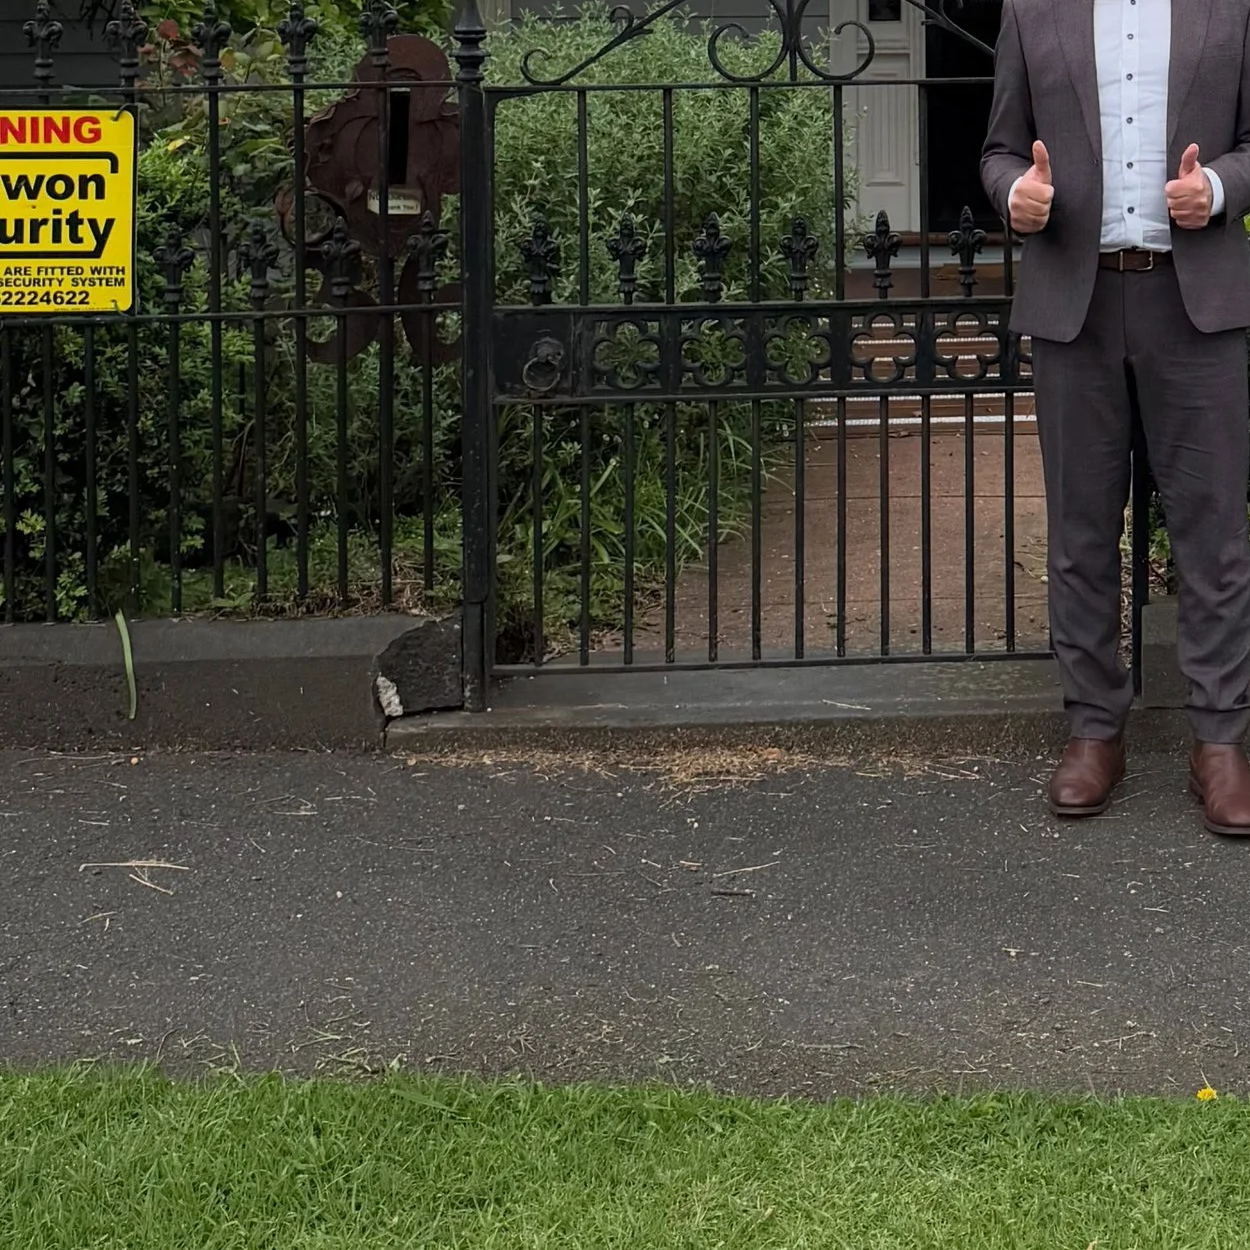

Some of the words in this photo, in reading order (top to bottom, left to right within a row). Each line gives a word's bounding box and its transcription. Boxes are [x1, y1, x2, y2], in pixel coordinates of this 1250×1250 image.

[0, 116, 101, 144] NING
[0, 174, 105, 200] won
[0, 209, 115, 257] urity
[3, 266, 32, 276] ARE
[37, 266, 84, 276] FITTED
[90, 266, 125, 275] WITH
[71, 277, 125, 287] SYSTEM
[0, 290, 90, 305] 2224622
